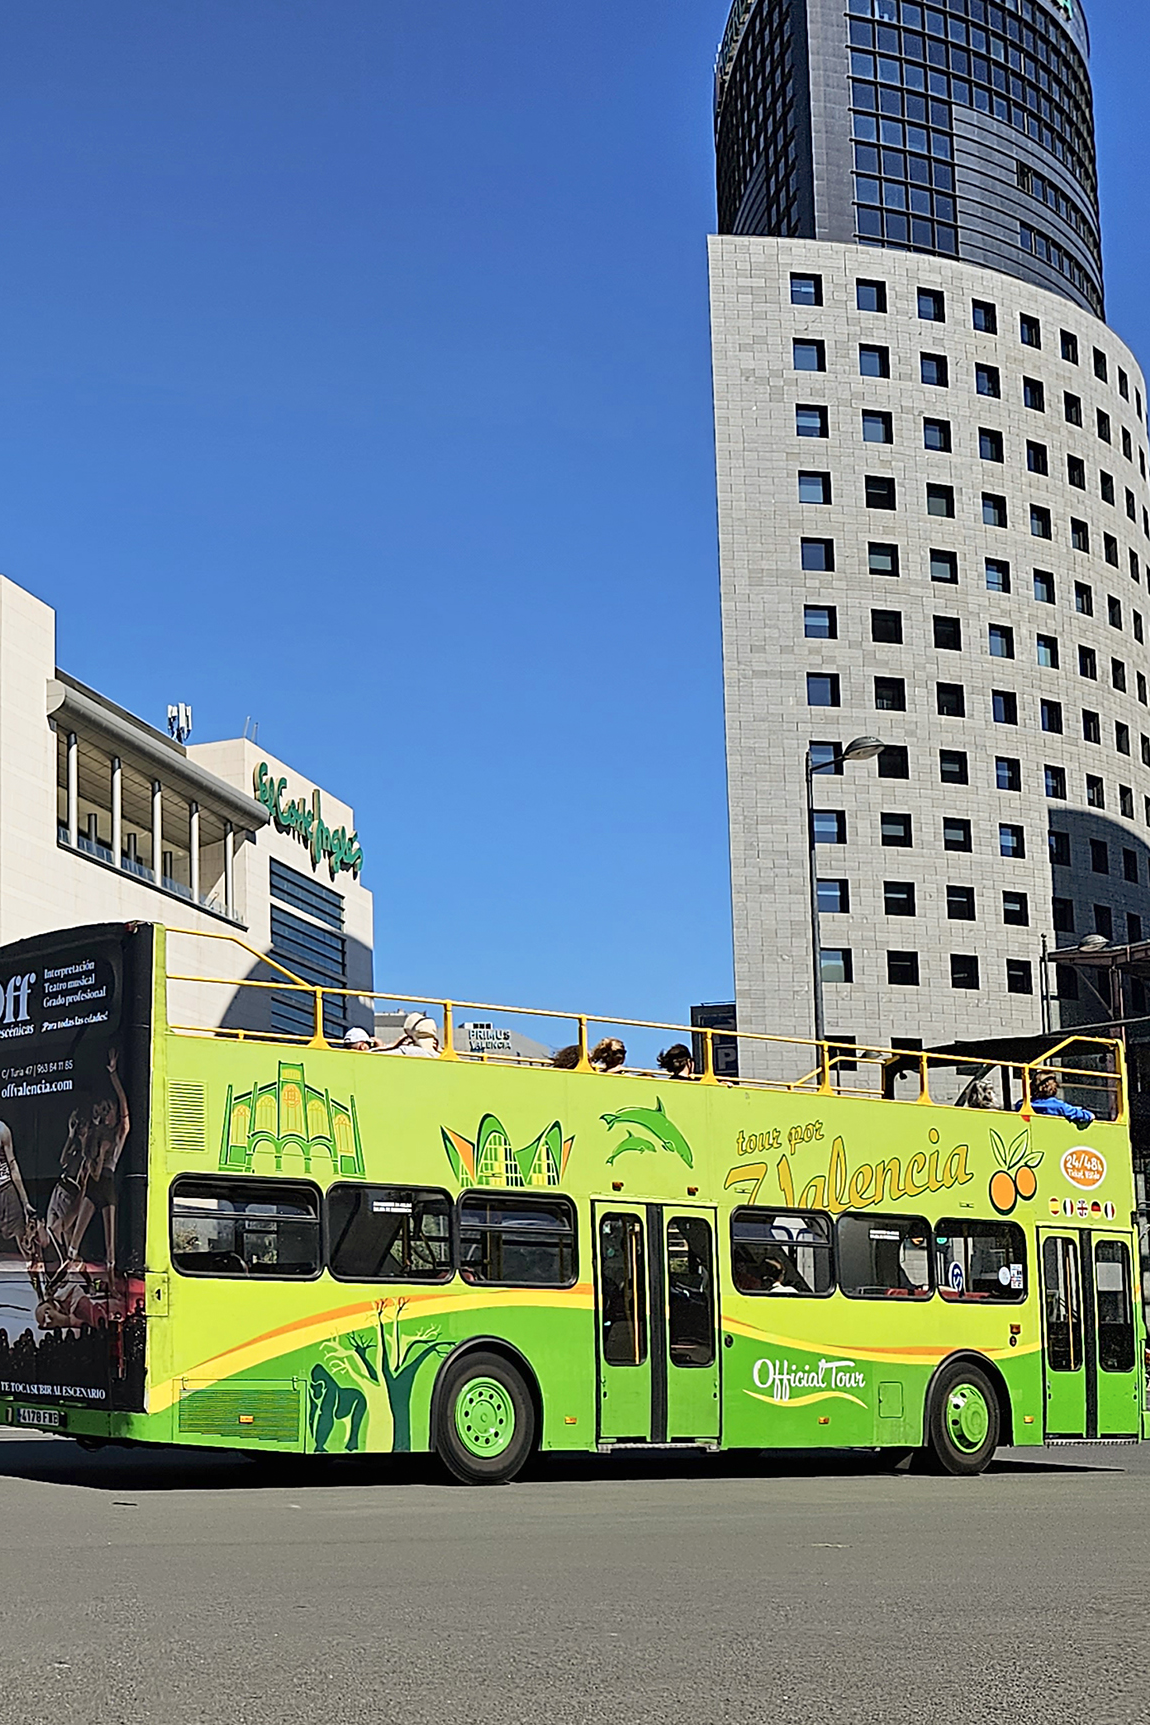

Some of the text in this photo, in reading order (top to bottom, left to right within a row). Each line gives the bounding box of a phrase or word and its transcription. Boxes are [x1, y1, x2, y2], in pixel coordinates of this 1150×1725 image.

[44, 959, 95, 979] Interpretación
[44, 973, 95, 993] Teatro musical
[43, 986, 106, 1008] Grado profesional
[468, 1029, 511, 1041] PRIMUS
[469, 1040, 511, 1050] VALENCIA
[717, 1048, 736, 1070] P
[1, 1079, 73, 1098] offvalencia.com
[736, 1120, 825, 1156] tour por
[724, 1127, 974, 1215] Valencia
[753, 1358, 866, 1402] Official Tour
